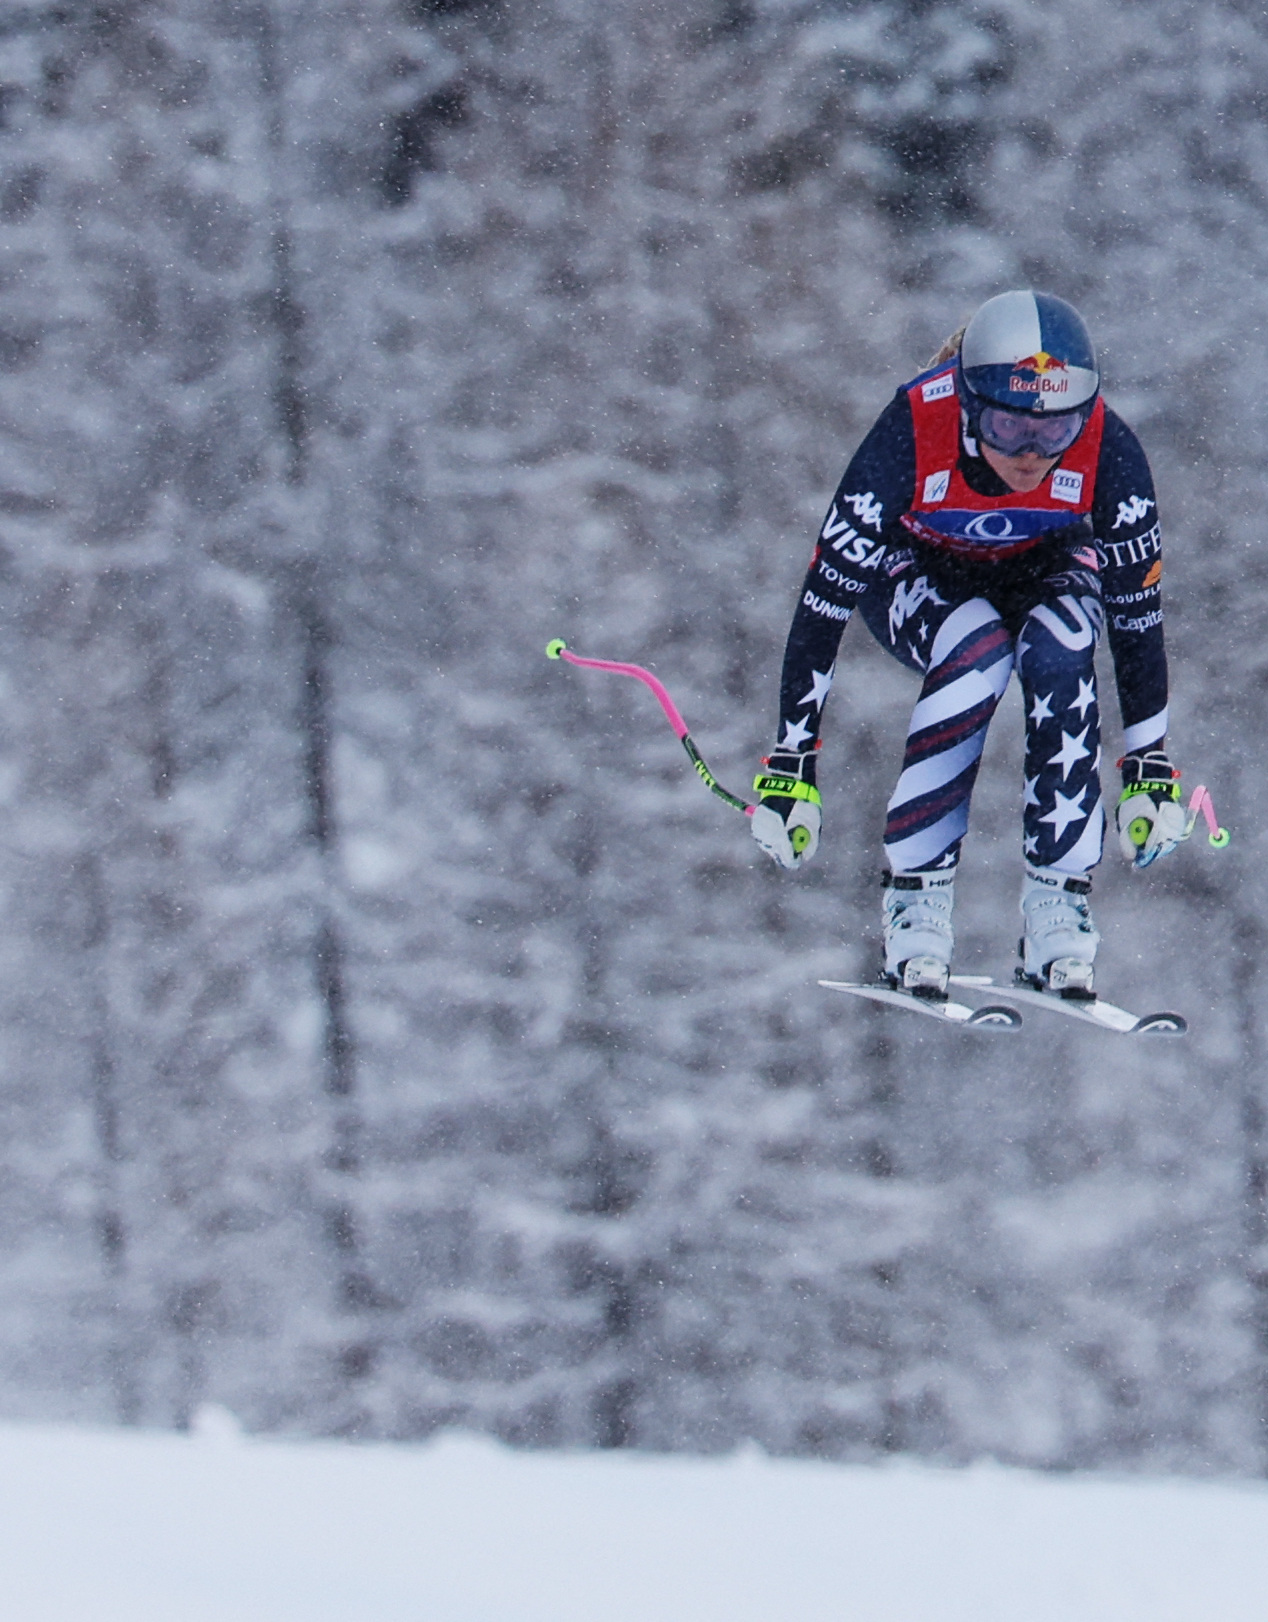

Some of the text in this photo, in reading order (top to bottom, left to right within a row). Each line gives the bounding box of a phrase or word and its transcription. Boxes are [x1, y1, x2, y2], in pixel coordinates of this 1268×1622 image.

[1010, 376, 1068, 392] Red Bull
[822, 502, 887, 570] VISA
